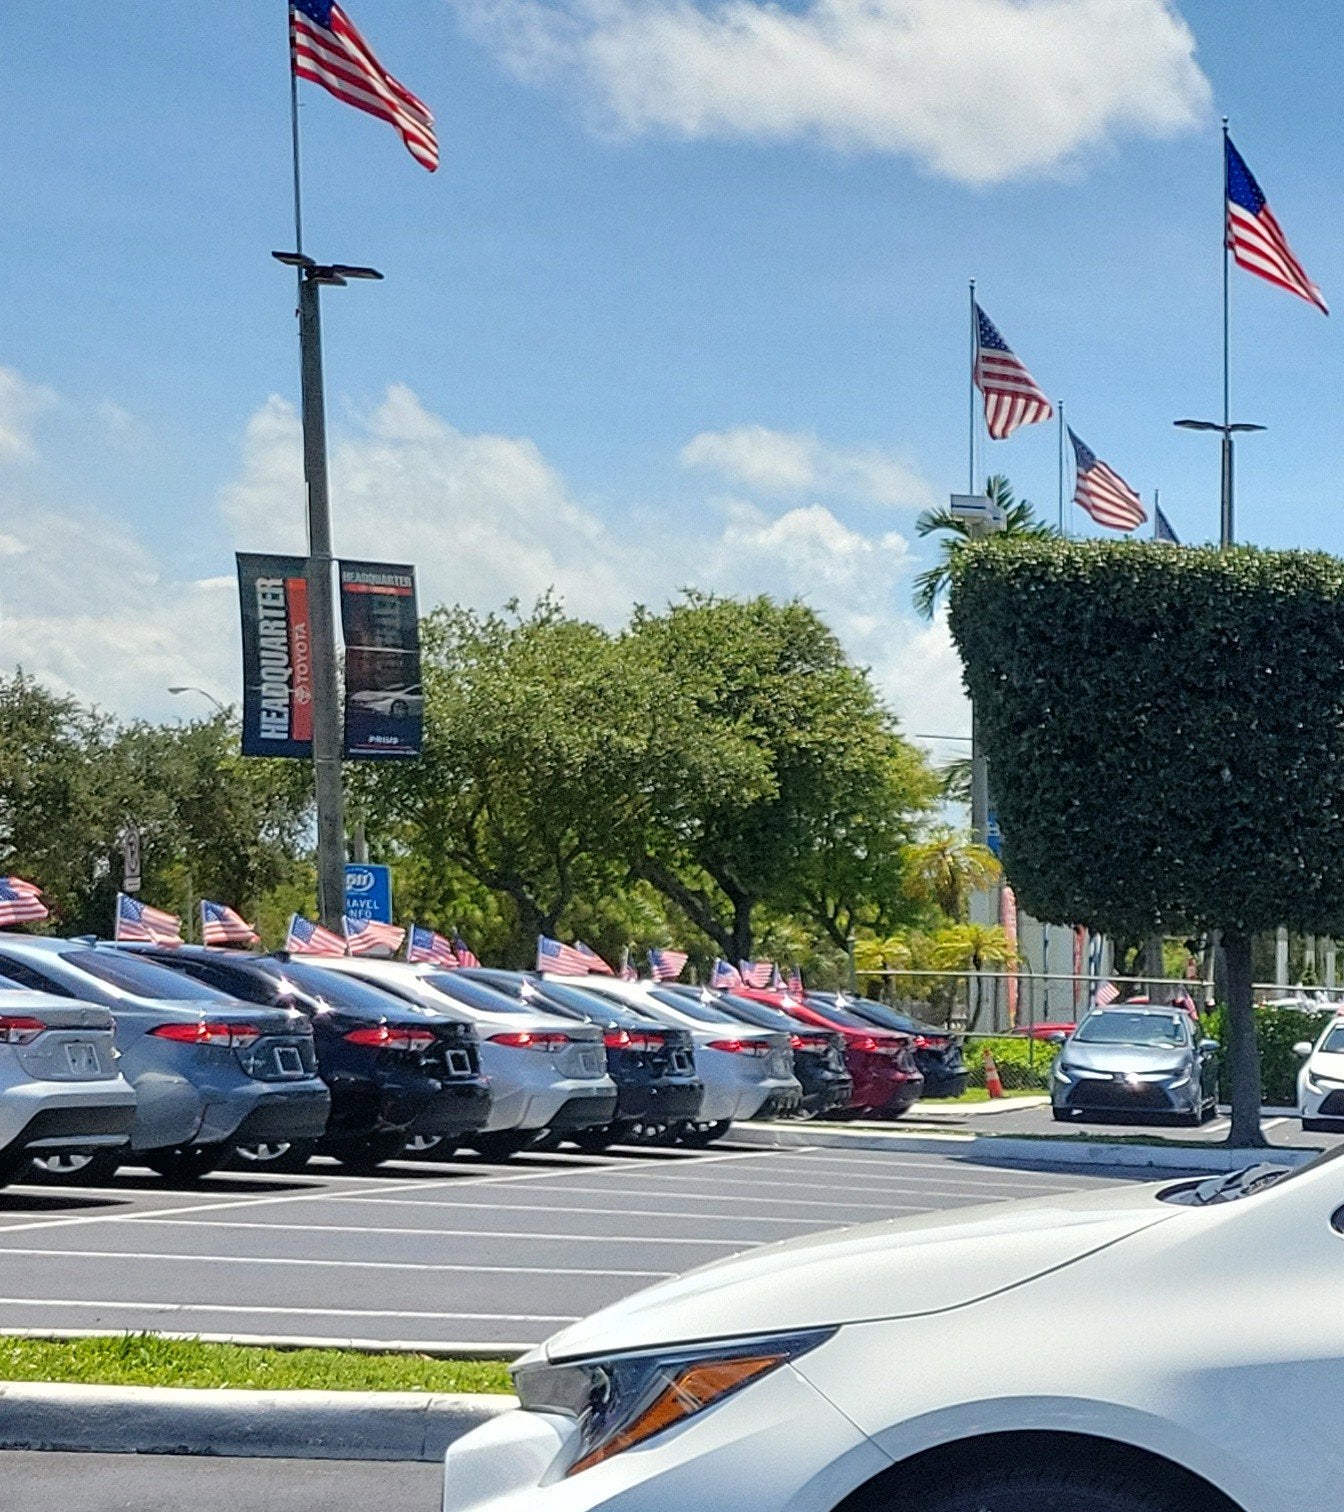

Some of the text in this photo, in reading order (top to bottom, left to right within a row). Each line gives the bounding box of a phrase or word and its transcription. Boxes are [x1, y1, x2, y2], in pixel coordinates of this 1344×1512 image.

[256, 577, 292, 739] HEADQUARTER
[294, 623, 309, 686] TOYOTA
[350, 908, 372, 919] NFO
